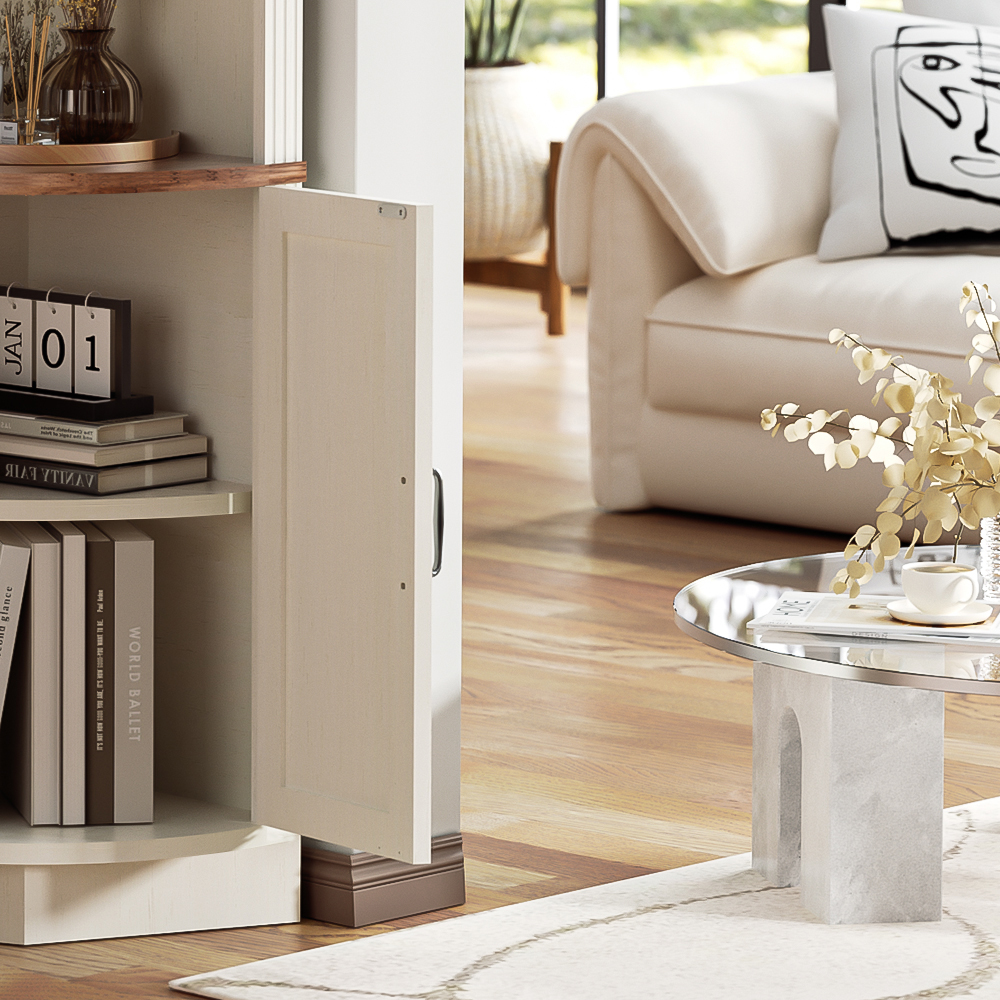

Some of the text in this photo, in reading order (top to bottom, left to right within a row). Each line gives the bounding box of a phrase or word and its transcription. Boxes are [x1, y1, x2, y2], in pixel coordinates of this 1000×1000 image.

[4, 318, 22, 376] JAN
[0, 586, 14, 622] glance
[128, 626, 142, 743] WORLD BALLET
